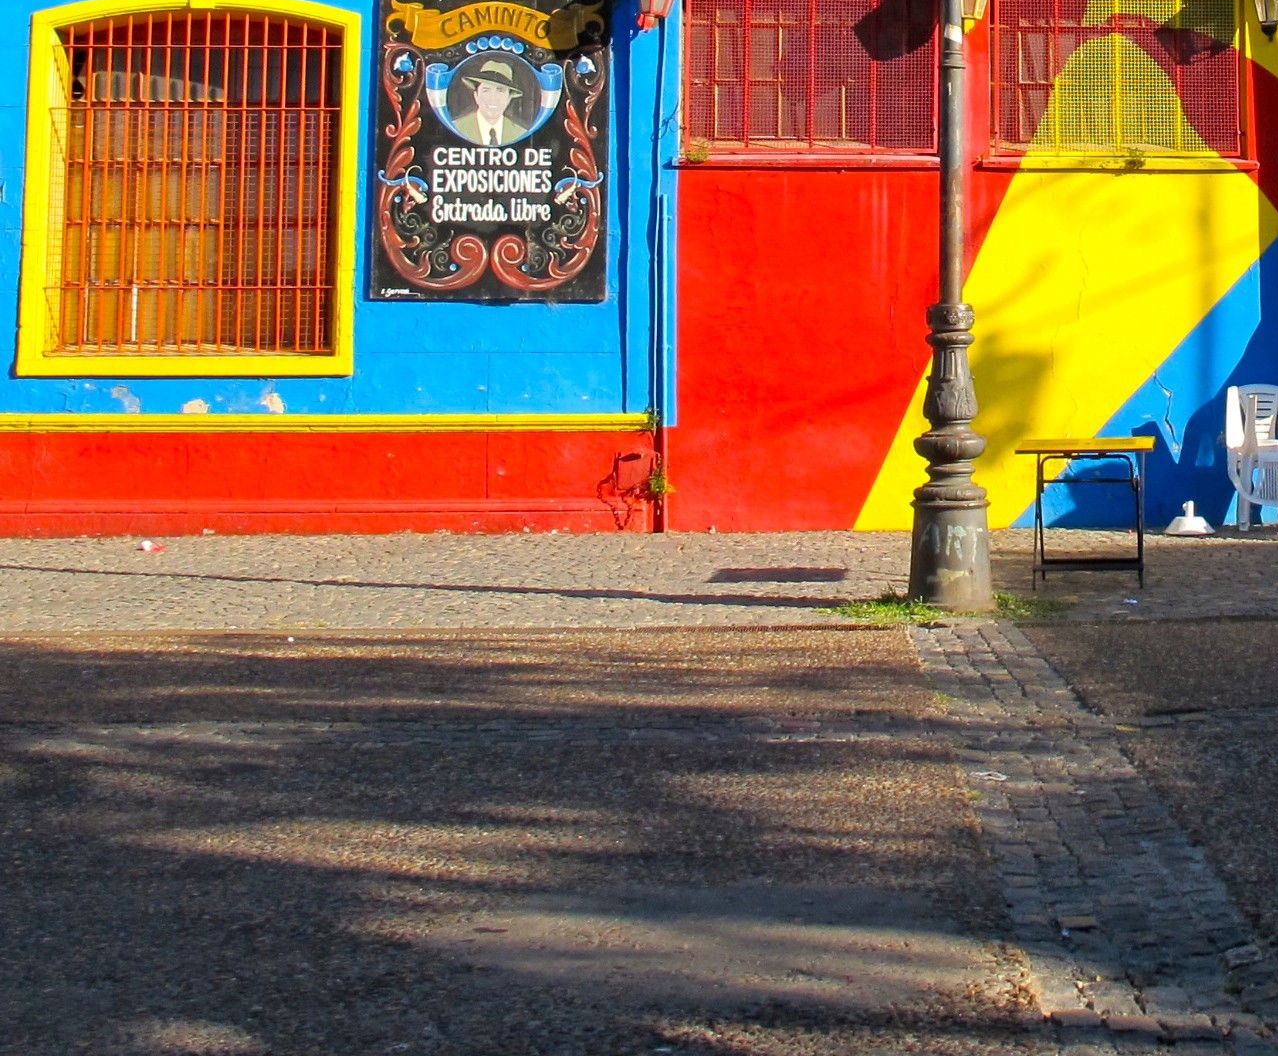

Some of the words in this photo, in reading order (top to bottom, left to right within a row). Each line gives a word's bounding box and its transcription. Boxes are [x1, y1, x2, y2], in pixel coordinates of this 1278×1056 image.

[441, 6, 551, 39] CAMINITO
[433, 147, 518, 166] CENTRO
[524, 148, 552, 166] DE
[432, 169, 552, 193] EXPOSICIONES
[432, 194, 508, 223] Entrada
[510, 197, 552, 222] libre
